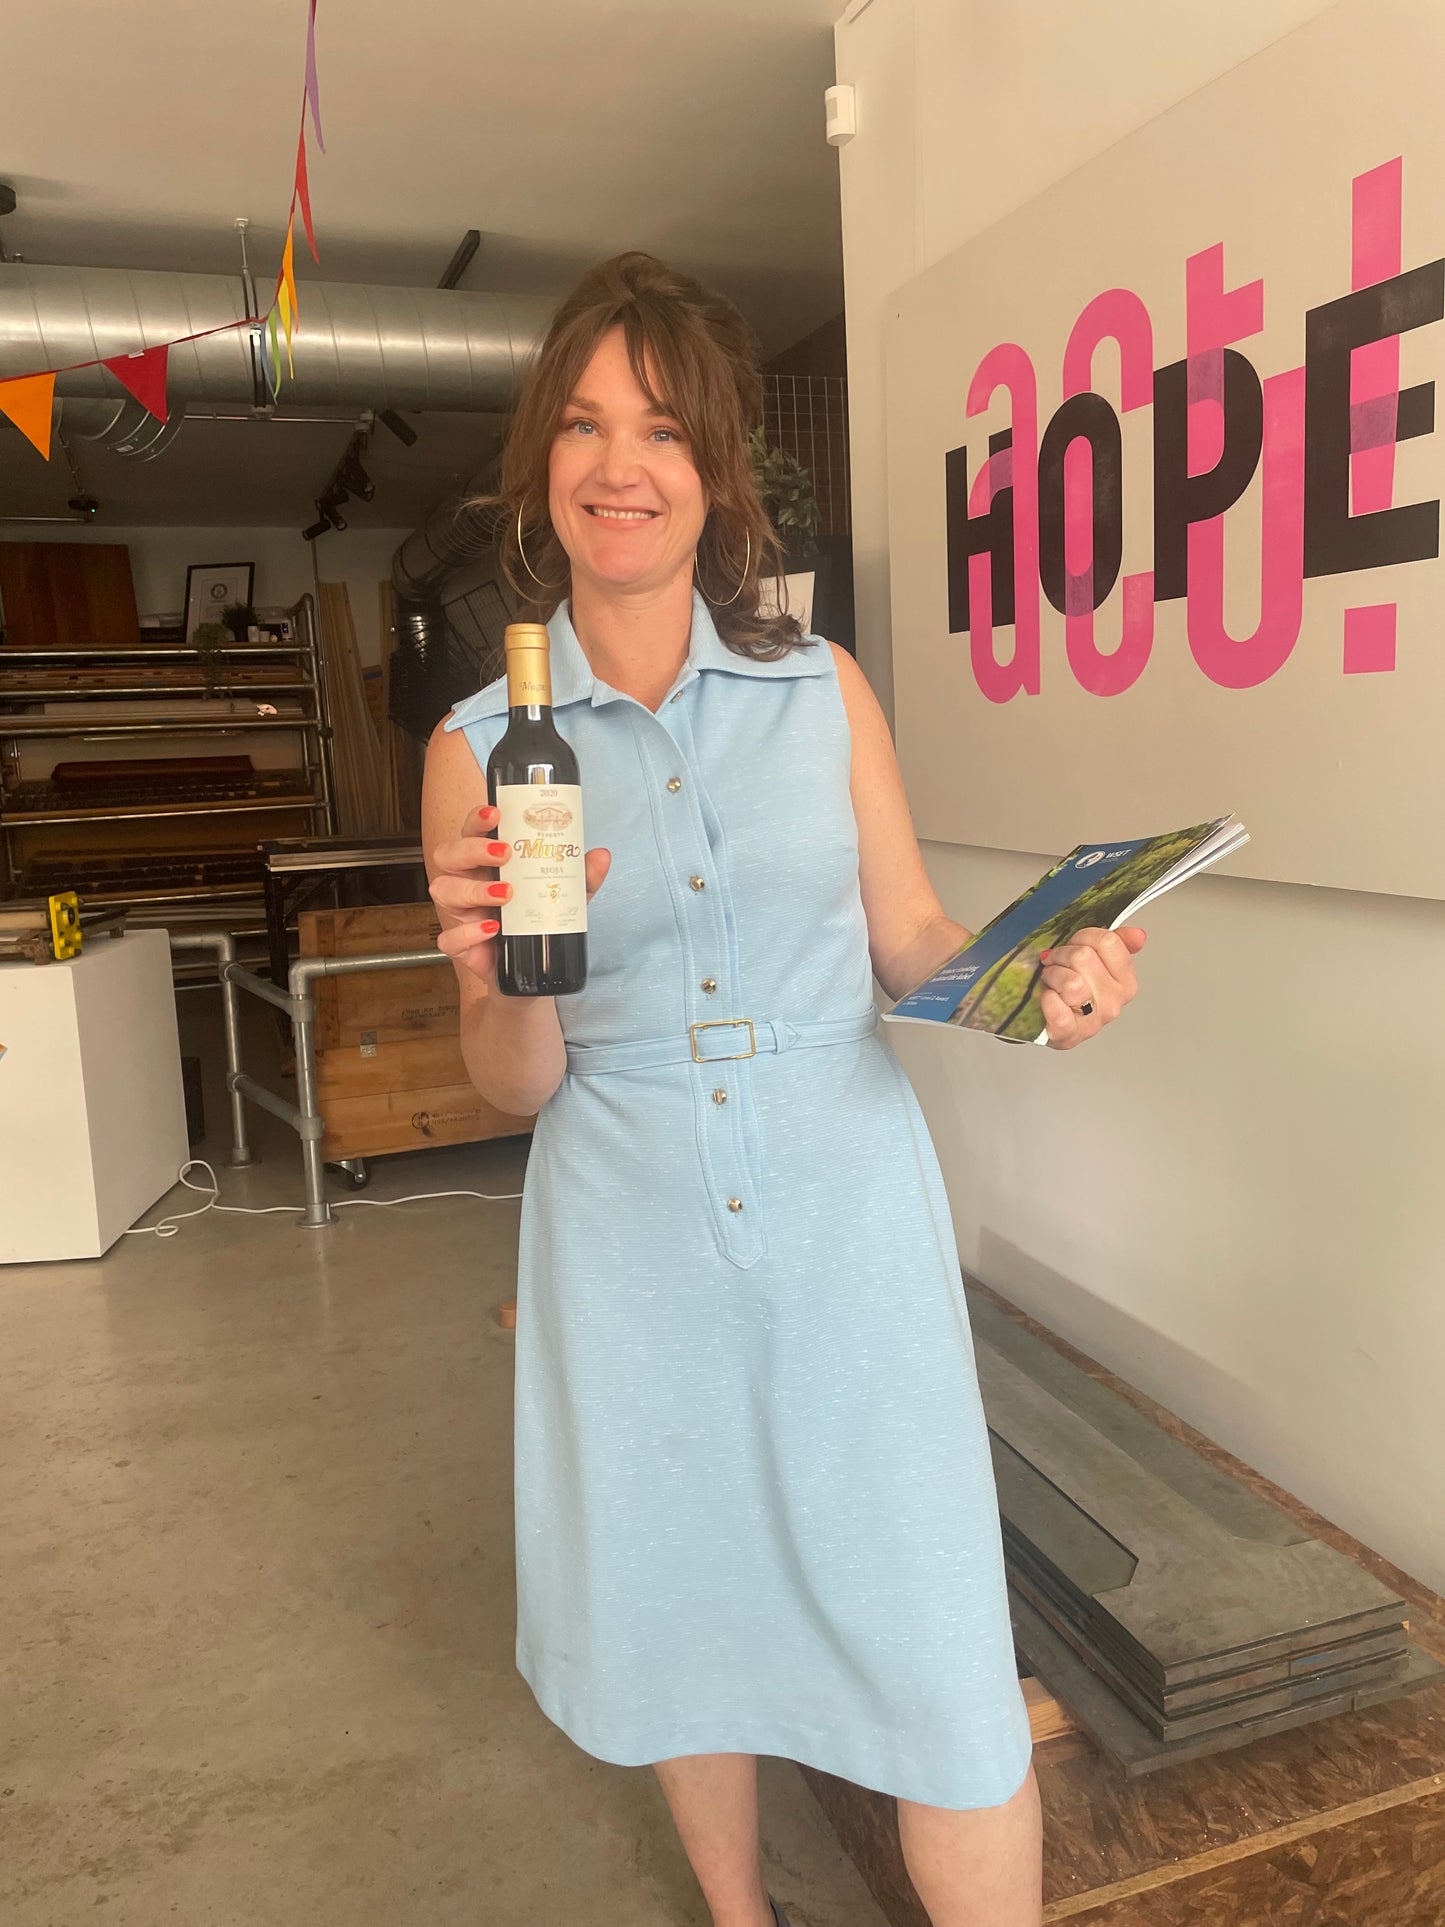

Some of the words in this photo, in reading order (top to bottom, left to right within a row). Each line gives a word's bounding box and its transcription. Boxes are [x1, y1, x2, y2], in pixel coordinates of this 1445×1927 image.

[945, 258, 1445, 633] HOPE
[520, 681, 547, 692] Muga
[540, 789, 558, 797] 2020
[514, 838, 580, 862] Muga
[540, 866, 564, 874] RIOJA
